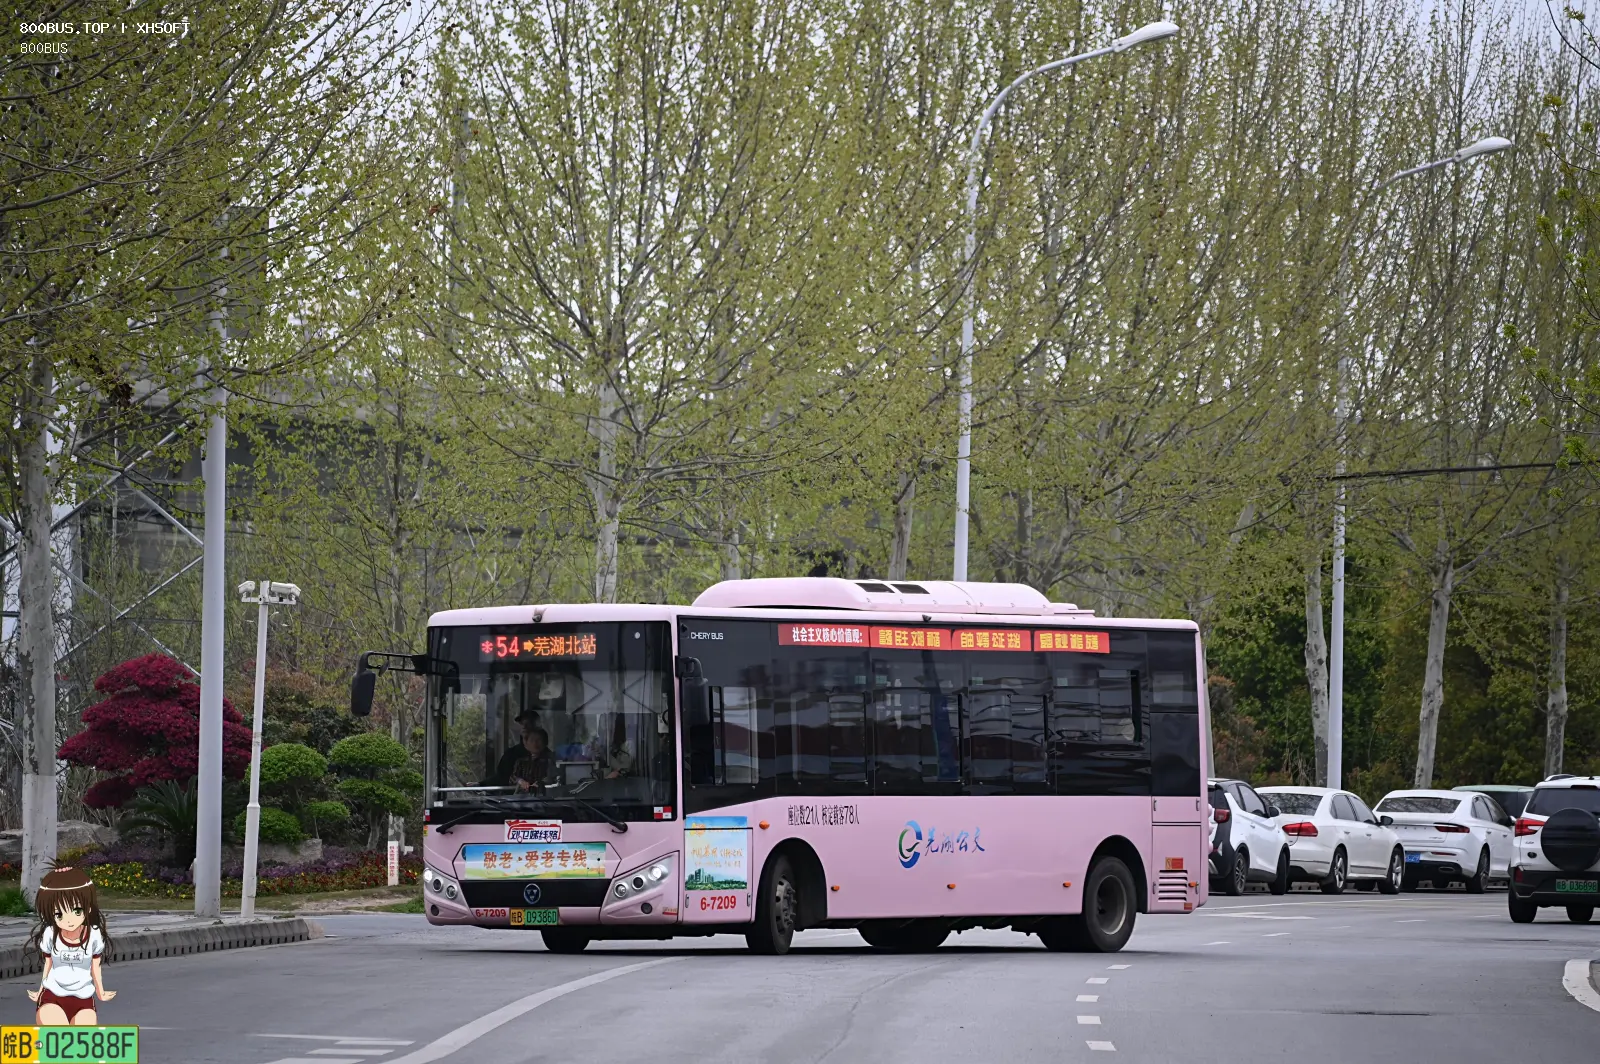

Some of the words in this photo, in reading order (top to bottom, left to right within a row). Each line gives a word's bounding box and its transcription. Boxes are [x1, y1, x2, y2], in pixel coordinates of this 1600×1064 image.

[690, 632, 711, 640] CHERY
[711, 632, 724, 640] BUS
[534, 634, 597, 656] 芜湖北站
[700, 895, 737, 911] 6-7209
[475, 908, 507, 918] 6-7209
